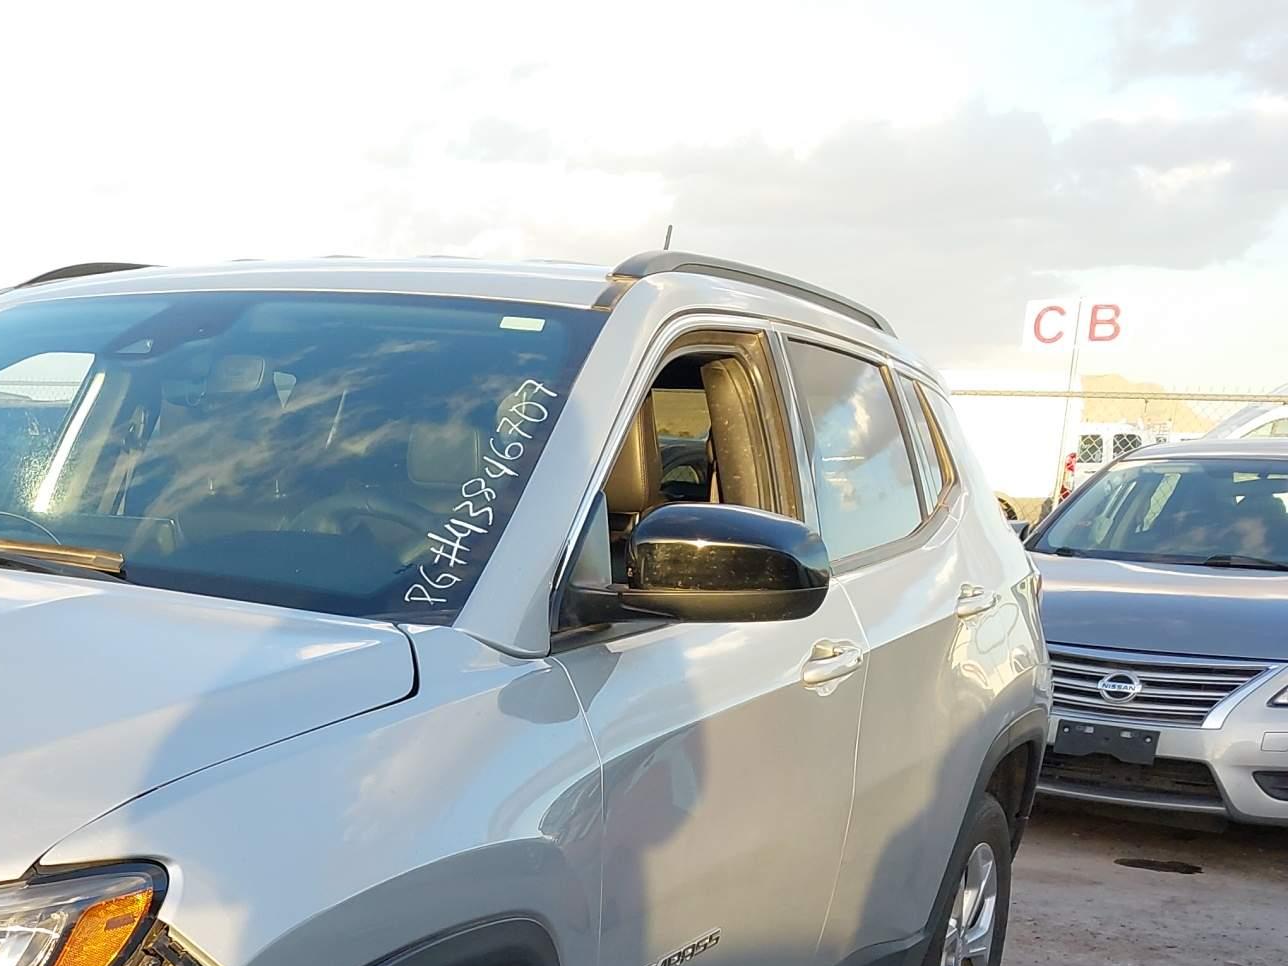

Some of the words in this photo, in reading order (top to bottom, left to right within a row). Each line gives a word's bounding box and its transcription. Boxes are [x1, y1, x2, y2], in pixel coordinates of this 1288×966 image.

[1033, 305, 1067, 344] C
[1088, 304, 1122, 342] B
[1101, 682, 1137, 692] NISSAN
